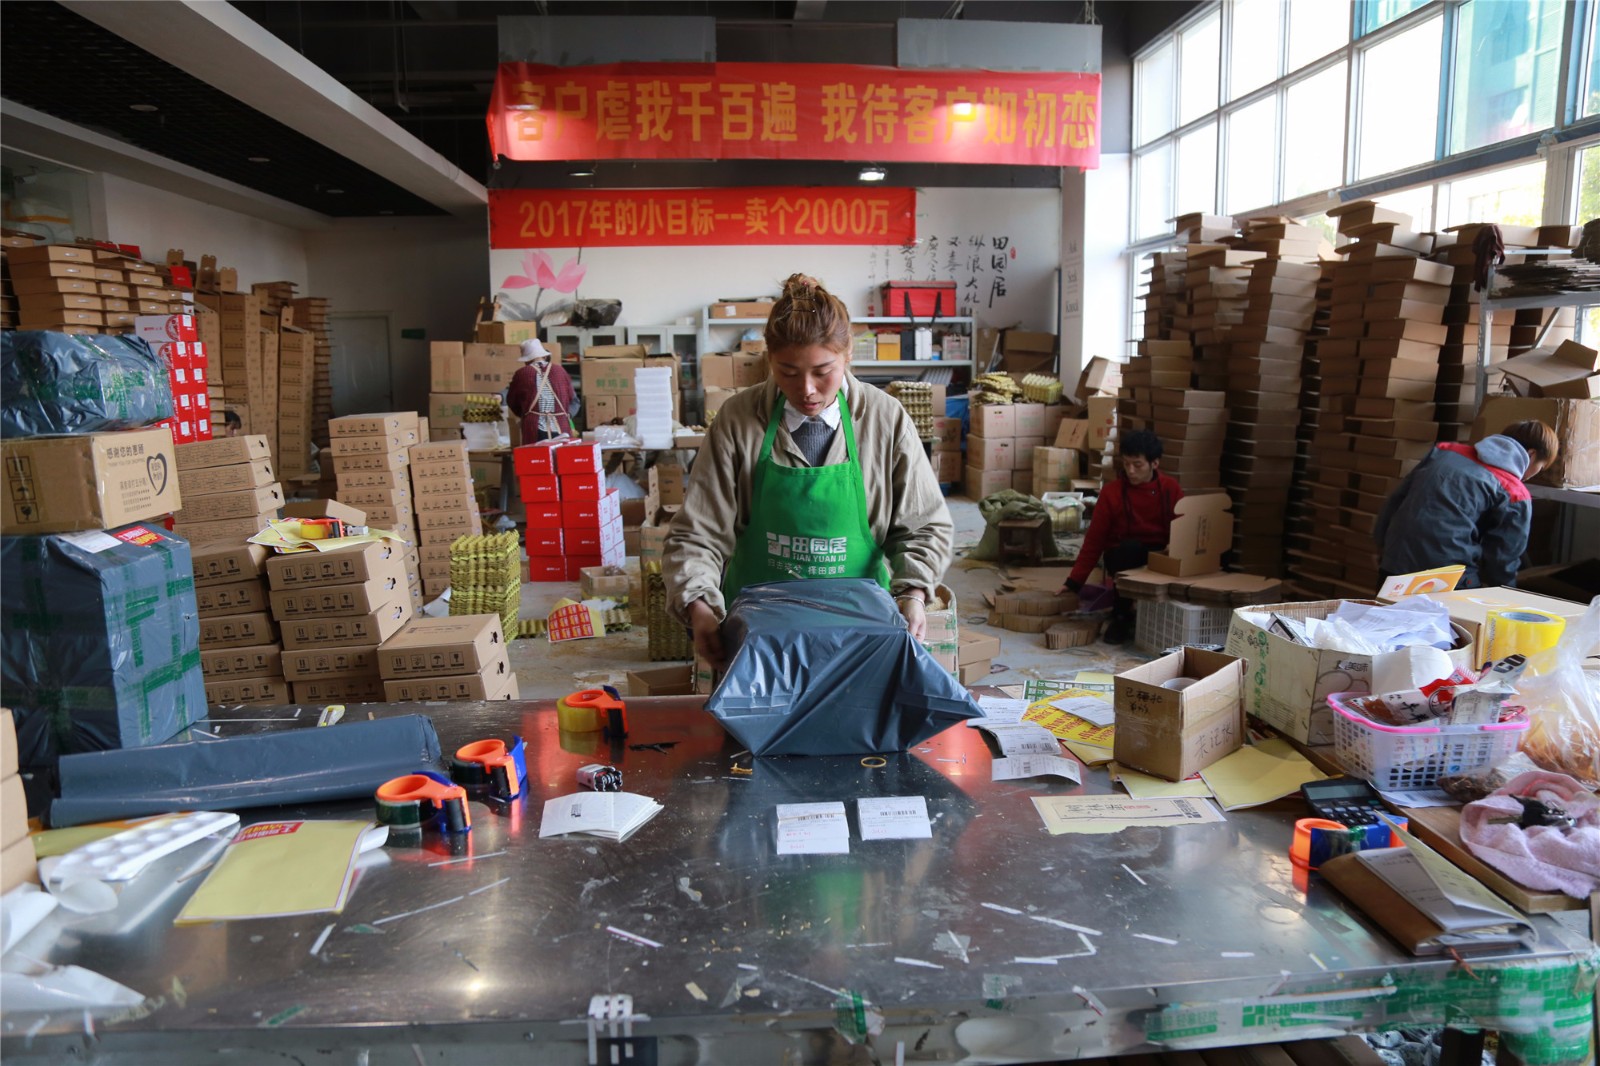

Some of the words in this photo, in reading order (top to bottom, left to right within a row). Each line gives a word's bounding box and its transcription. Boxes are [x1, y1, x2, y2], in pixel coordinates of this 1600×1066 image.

[512, 80, 797, 142] 客户虐我千百遍
[821, 82, 1097, 149] 我待客户如初恋
[792, 536, 847, 555] 田园居
[792, 552, 811, 562] TIAN
[813, 554, 836, 563] YUAN
[837, 553, 847, 562] JU
